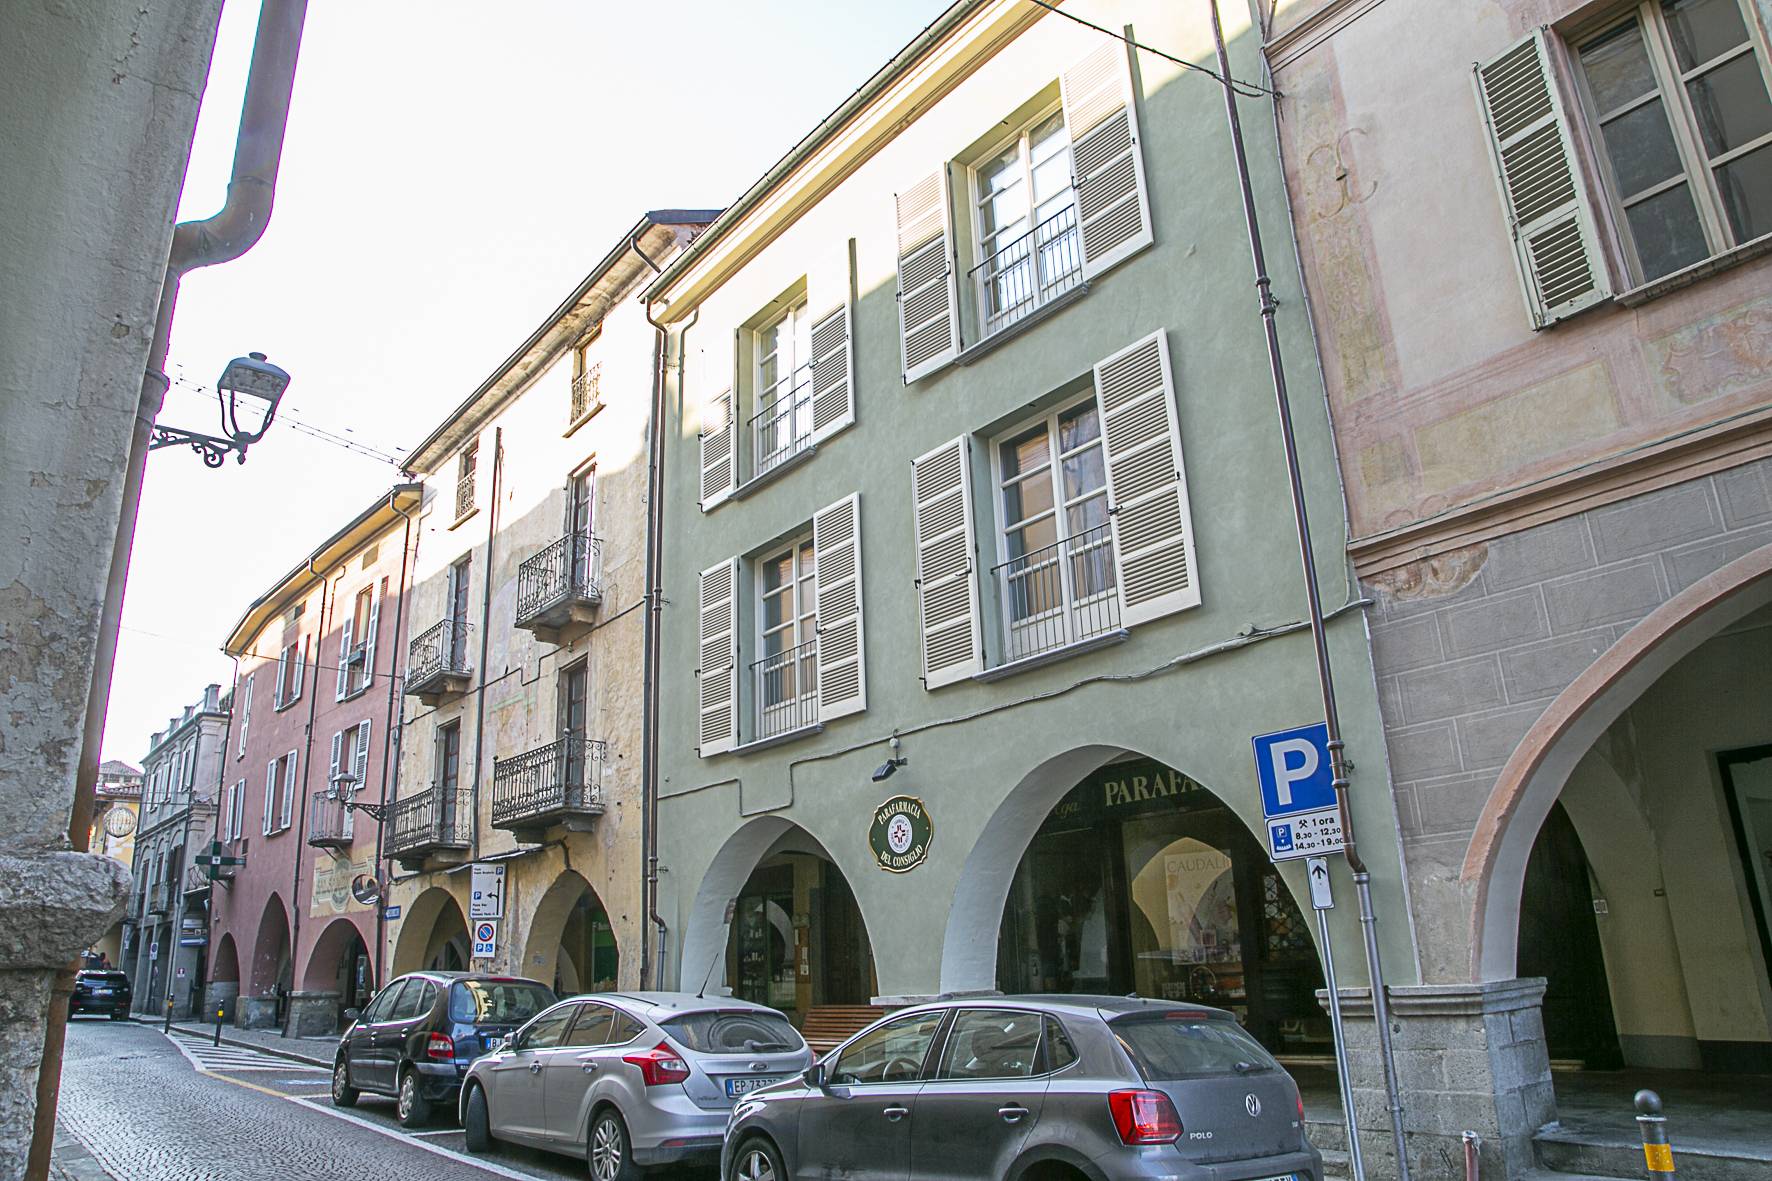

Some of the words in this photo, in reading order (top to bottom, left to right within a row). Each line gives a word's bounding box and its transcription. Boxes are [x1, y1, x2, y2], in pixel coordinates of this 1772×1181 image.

[1269, 738, 1318, 806] P
[878, 801, 921, 825] PARAFARMACIA
[1312, 818, 1316, 826] 1
[1318, 817, 1334, 826] ora
[1295, 832, 1312, 840] 8.30
[1320, 827, 1341, 836] 12.30
[880, 850, 891, 865] DEL
[893, 844, 923, 867] CONSIGLIO
[1190, 1132, 1213, 1140] POLO
